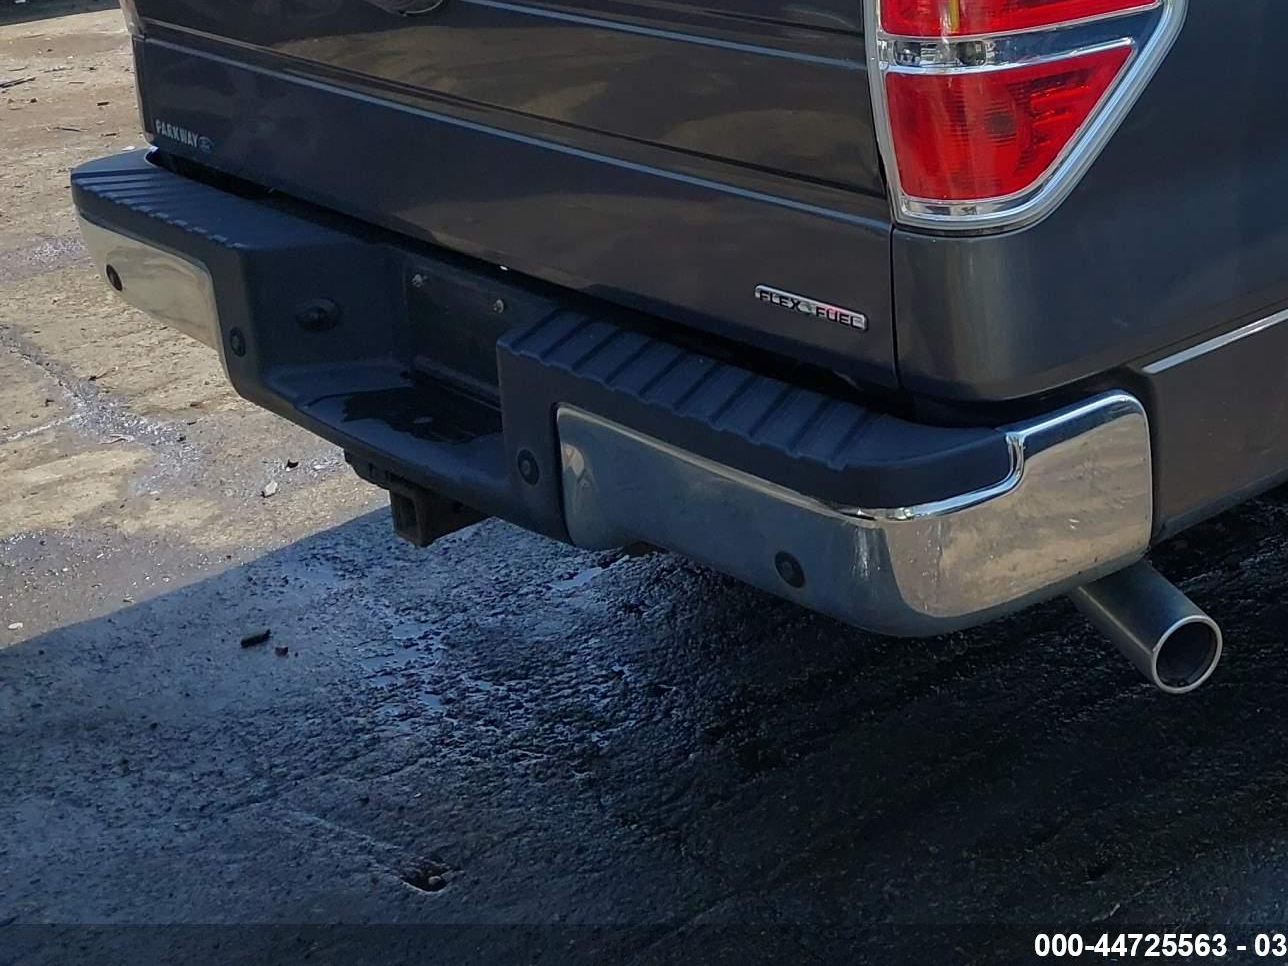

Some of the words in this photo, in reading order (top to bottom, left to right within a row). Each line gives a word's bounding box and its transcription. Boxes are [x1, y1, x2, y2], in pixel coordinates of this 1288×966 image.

[155, 119, 199, 147] PARKWAY
[756, 288, 802, 314] FLEX
[815, 305, 867, 331] FUEL
